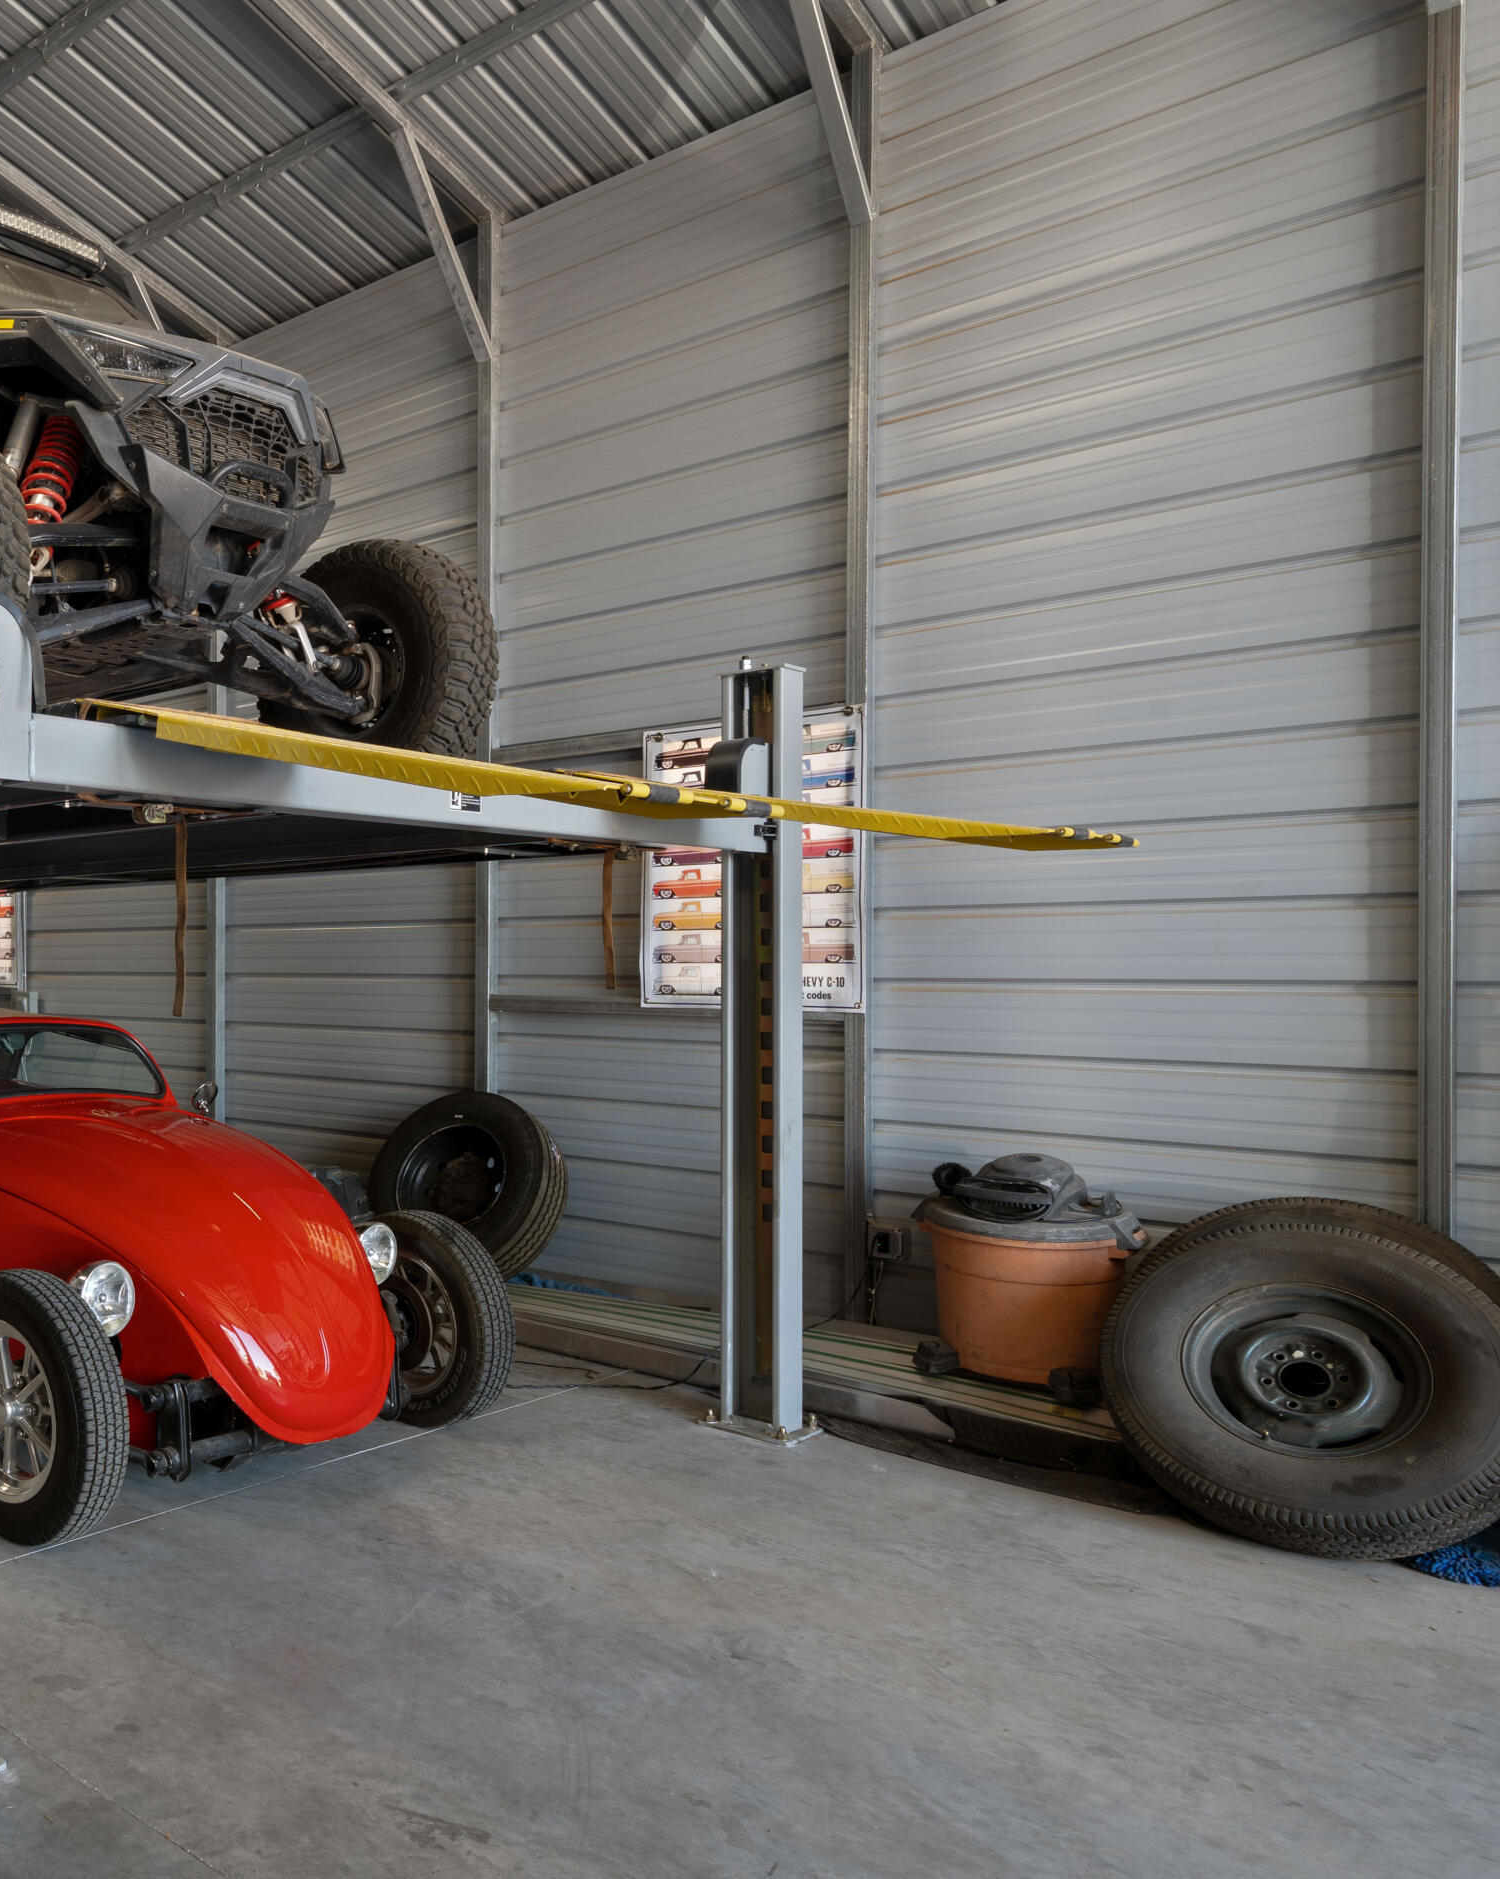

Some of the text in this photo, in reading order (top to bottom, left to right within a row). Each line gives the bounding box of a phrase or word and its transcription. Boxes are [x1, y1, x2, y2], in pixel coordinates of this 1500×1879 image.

[802, 976, 845, 988] HEVY C-10
[806, 991, 832, 1000] codes
